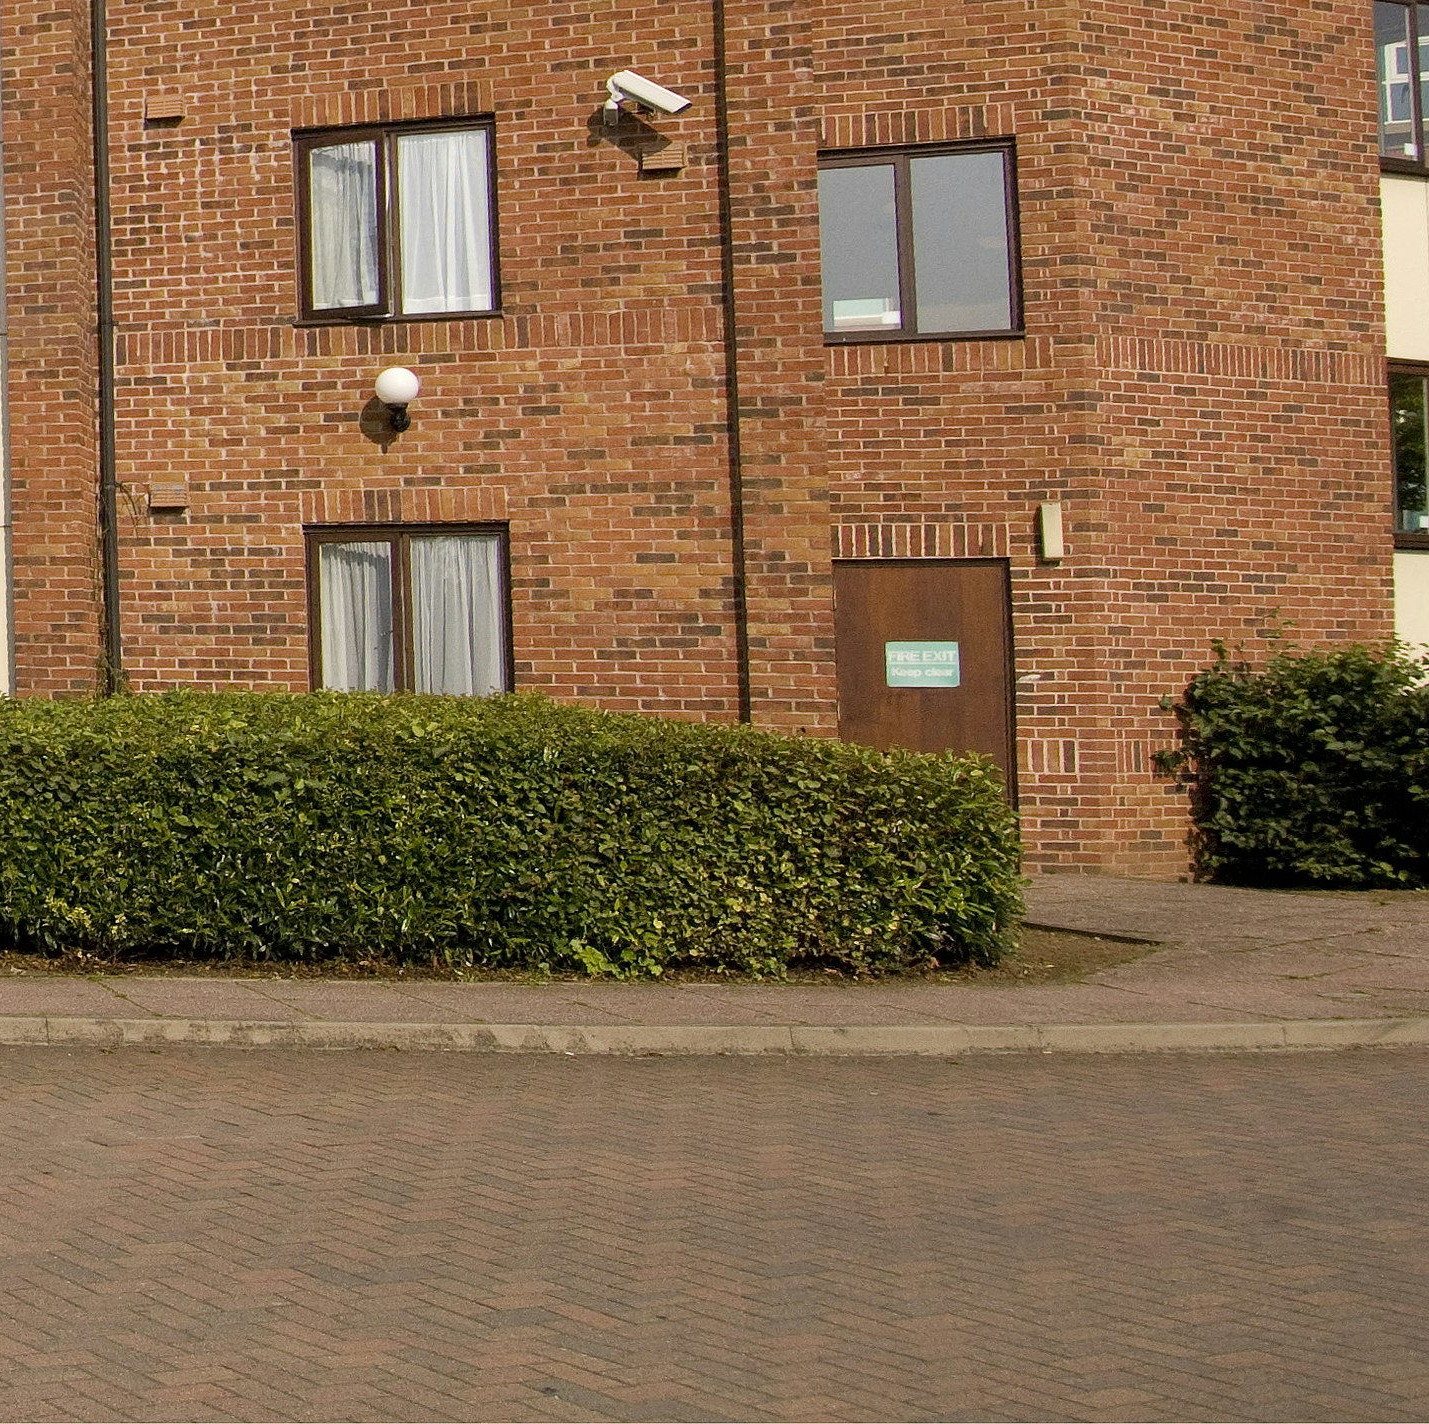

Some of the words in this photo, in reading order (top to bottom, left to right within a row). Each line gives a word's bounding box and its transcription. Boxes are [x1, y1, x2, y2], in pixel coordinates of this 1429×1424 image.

[888, 650, 921, 661] FIRE
[922, 650, 956, 661] EXIT
[891, 667, 922, 678] Keep
[925, 667, 953, 677] clear
